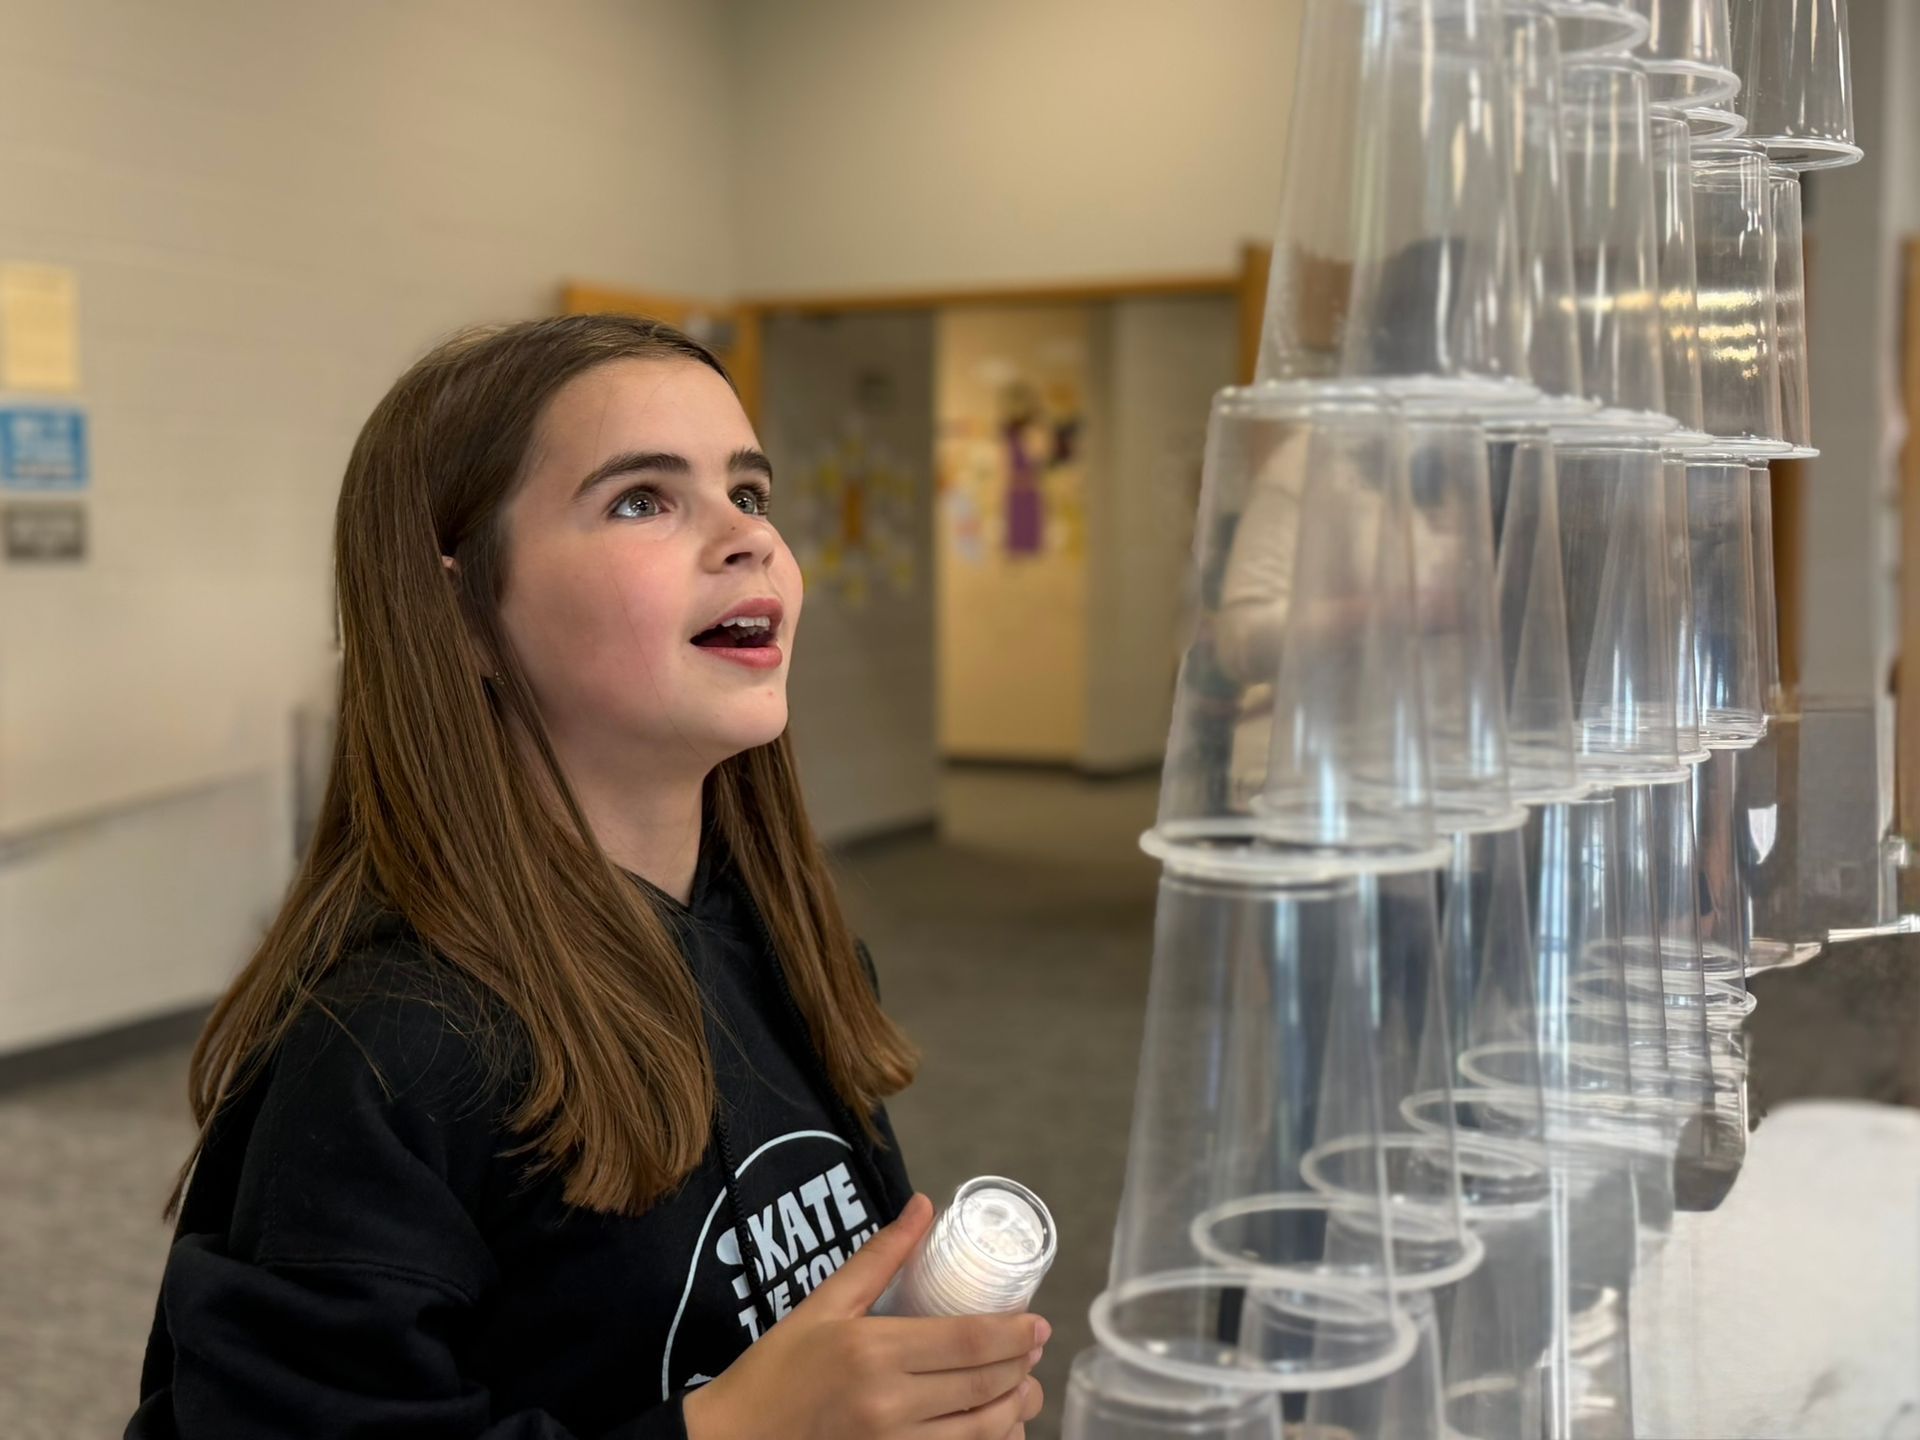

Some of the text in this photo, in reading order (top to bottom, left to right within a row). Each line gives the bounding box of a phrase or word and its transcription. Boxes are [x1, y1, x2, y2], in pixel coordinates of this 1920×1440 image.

[716, 1162, 868, 1300] SKATE
[738, 1222, 880, 1343] TE TO
